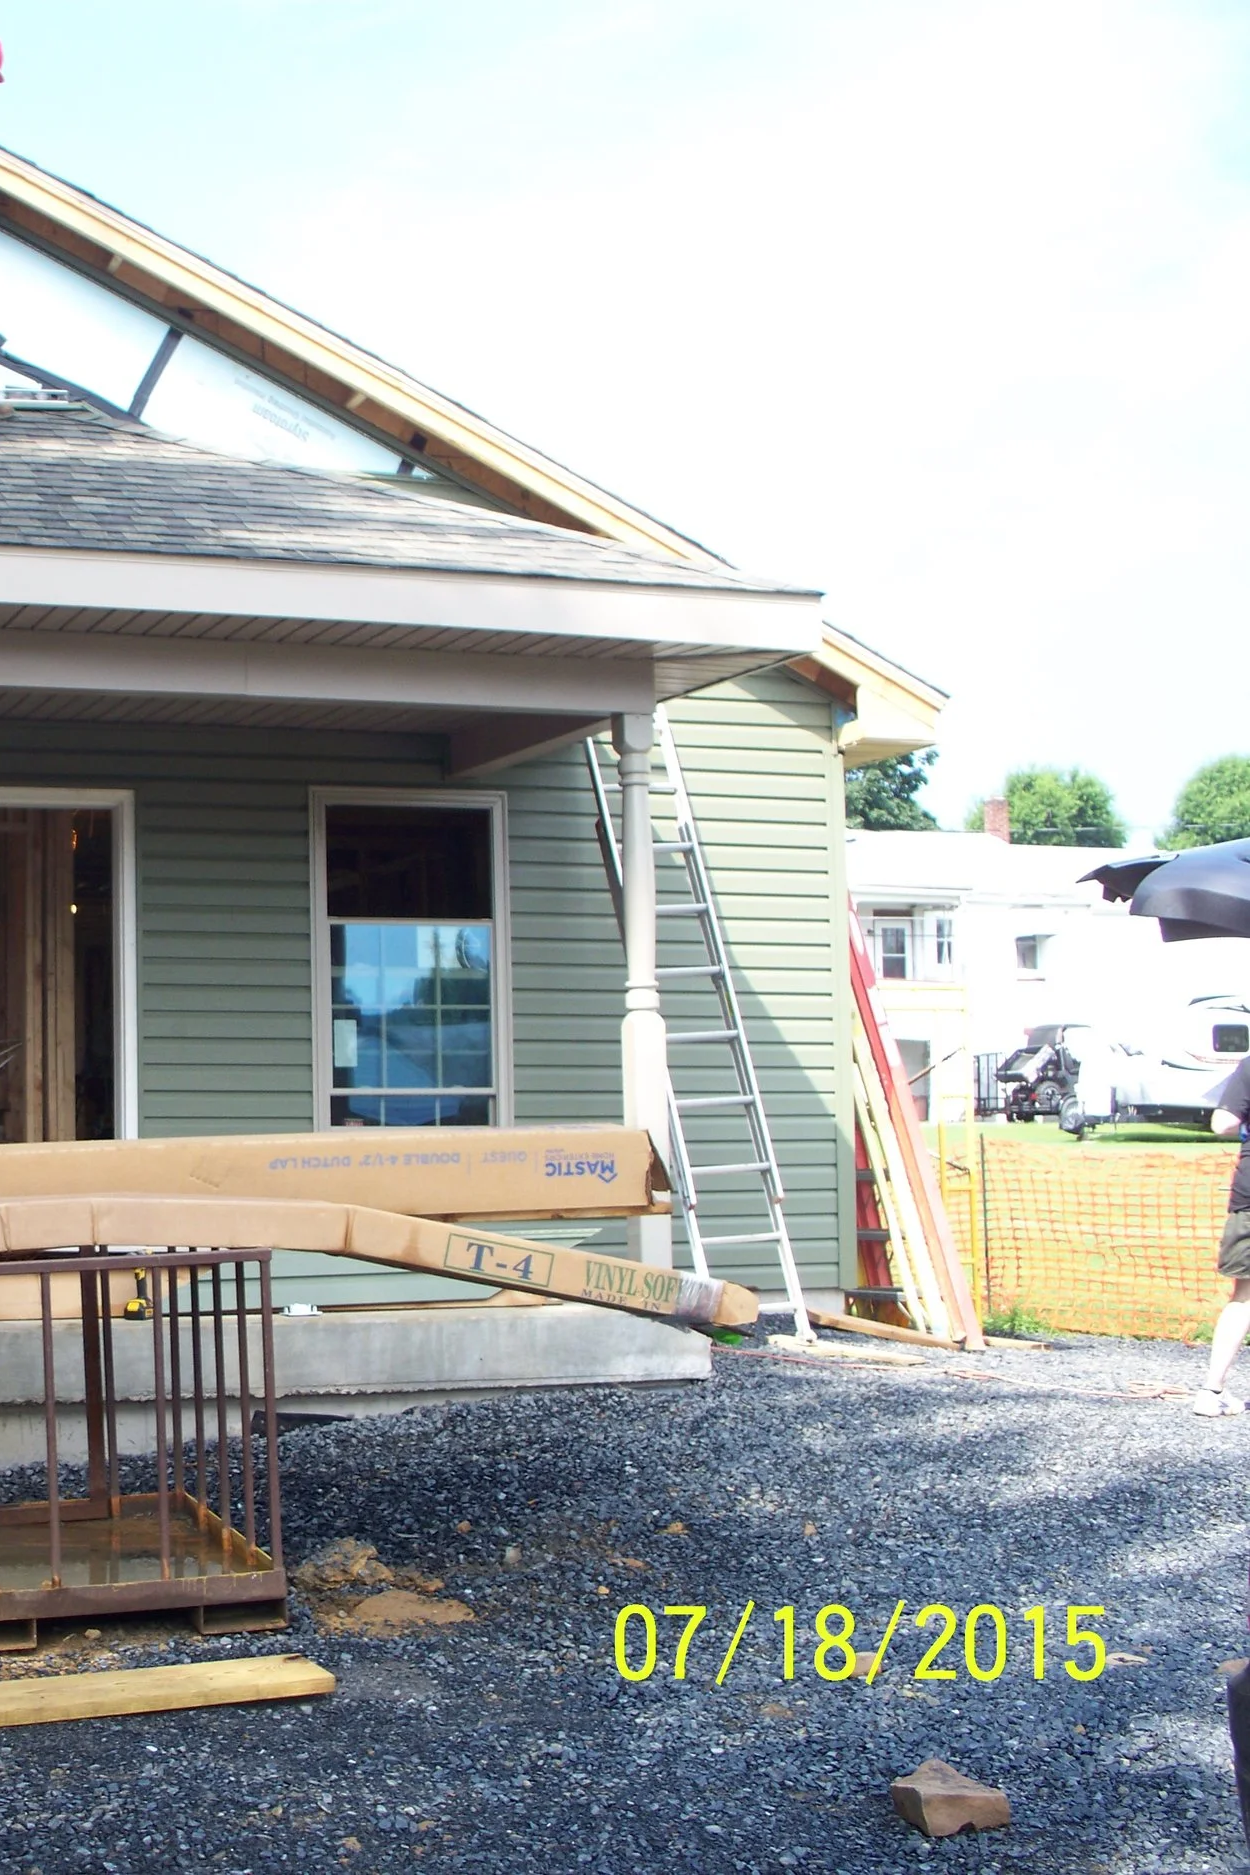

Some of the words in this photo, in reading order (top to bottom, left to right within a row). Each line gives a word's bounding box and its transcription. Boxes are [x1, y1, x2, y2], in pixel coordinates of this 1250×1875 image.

[268, 1158, 298, 1170] LAP
[301, 1155, 351, 1168] DUTCH
[402, 1153, 461, 1166] DOUBLE
[481, 1150, 528, 1164] QUEST
[545, 1159, 616, 1177] MASTIC
[466, 1242, 534, 1281] T-4
[584, 1259, 638, 1297] VINYL
[581, 1288, 628, 1306] MADE
[643, 1300, 662, 1311] IN
